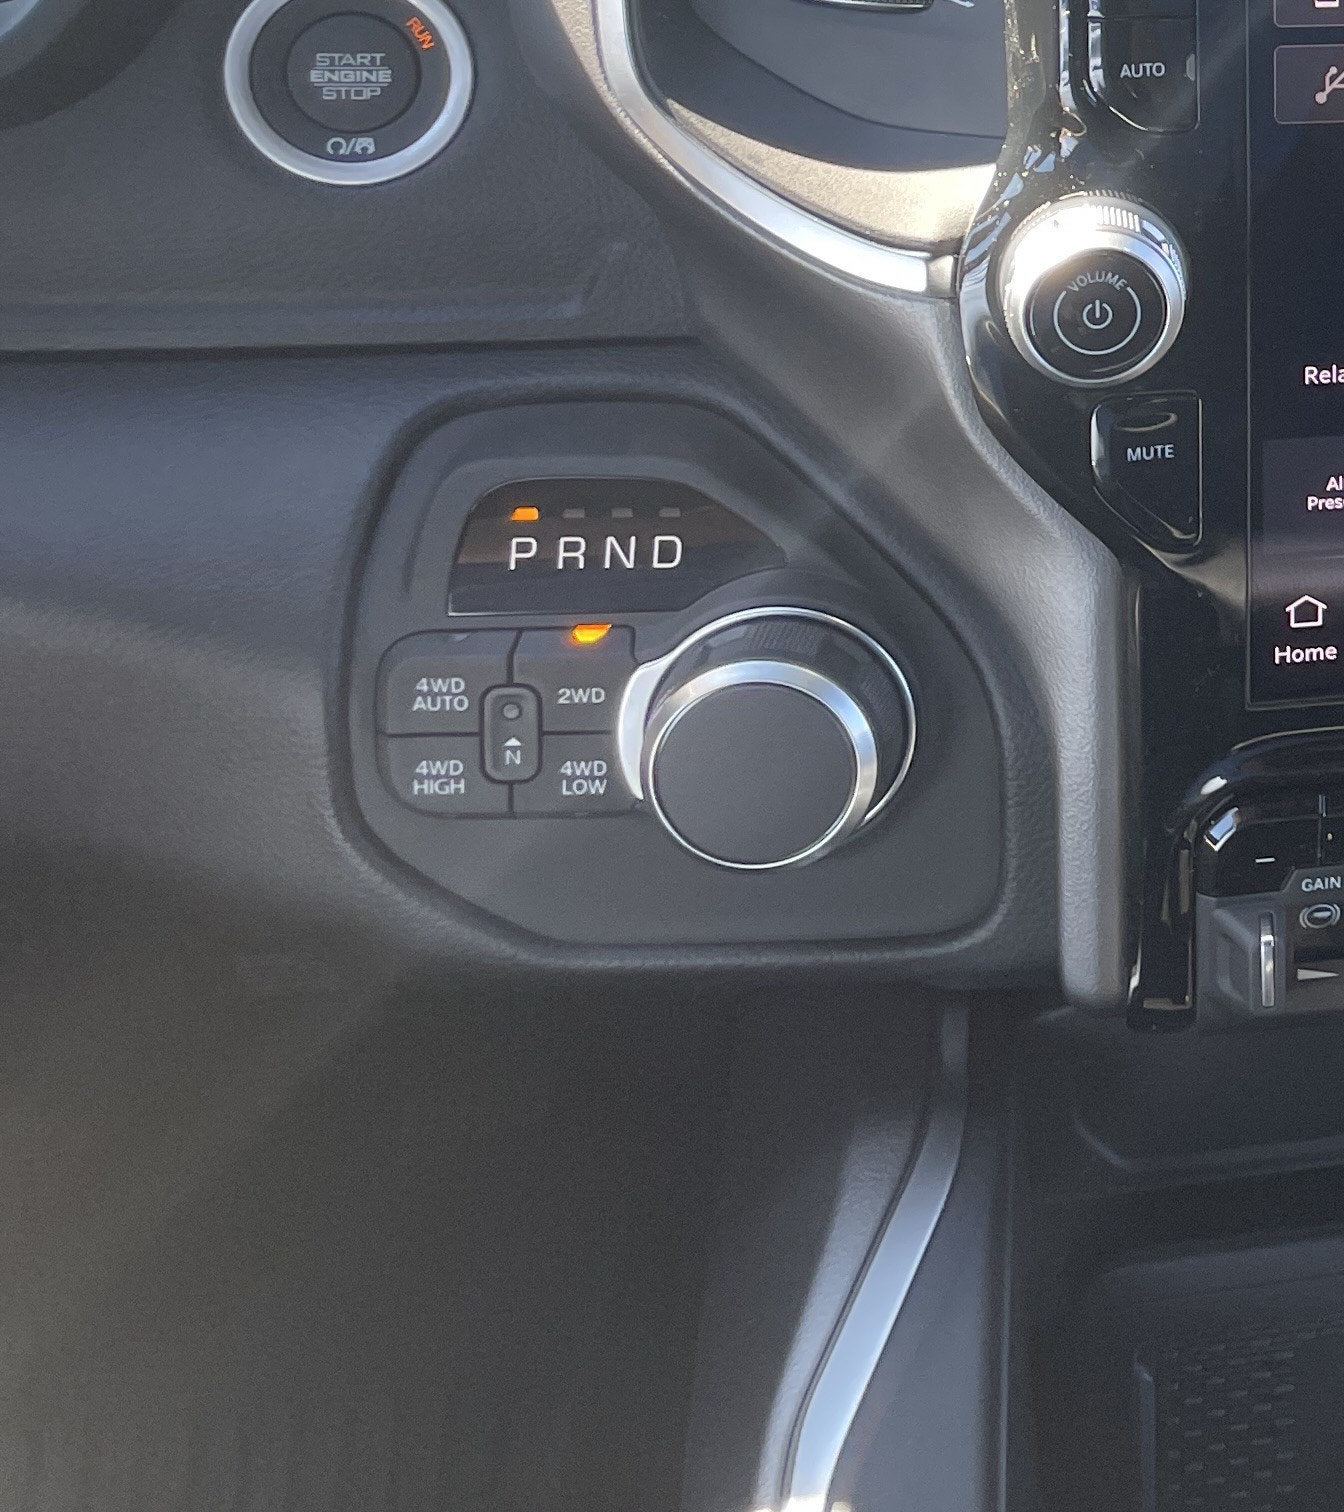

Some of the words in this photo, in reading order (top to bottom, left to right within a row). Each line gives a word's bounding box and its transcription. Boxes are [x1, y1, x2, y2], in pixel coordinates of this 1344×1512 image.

[405, 15, 435, 51] RUN
[315, 52, 386, 67] START
[309, 69, 392, 83] ENGINE
[1119, 62, 1165, 79] AUTO
[322, 87, 381, 101] STOP
[1067, 269, 1128, 292] VOLUME
[1126, 444, 1175, 463] MUTE
[508, 536, 538, 571] P
[557, 536, 586, 570] R
[603, 535, 637, 570] N
[651, 534, 683, 569] D
[1273, 643, 1338, 665] Home
[415, 677, 465, 694] 4WD
[411, 695, 470, 712] AUTO
[556, 687, 606, 705] 2WD
[504, 749, 522, 766] N
[414, 759, 464, 776] 4WD
[559, 759, 608, 776] 4WD
[412, 778, 466, 795] HIGH
[561, 778, 608, 796] LOW
[1301, 875, 1342, 892] GAIN
